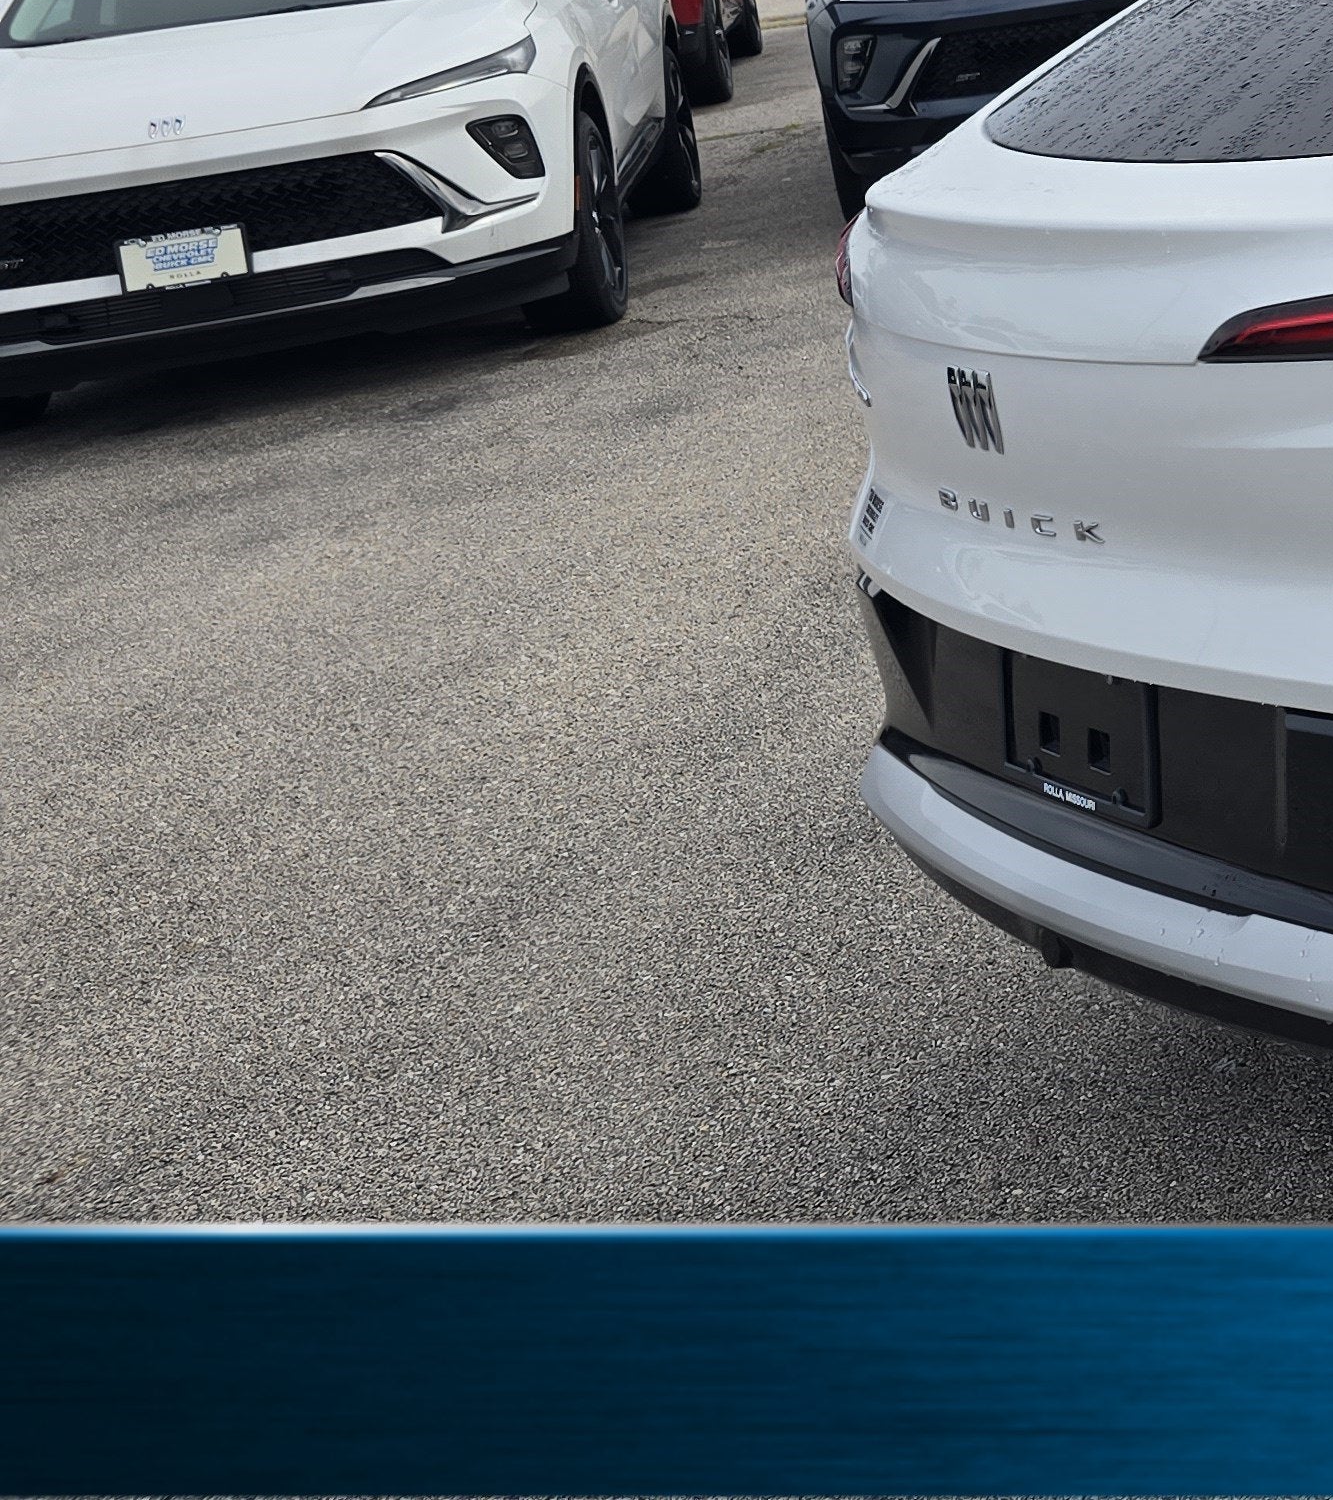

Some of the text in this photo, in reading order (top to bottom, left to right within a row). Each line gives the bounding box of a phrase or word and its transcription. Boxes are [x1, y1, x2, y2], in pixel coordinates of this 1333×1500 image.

[146, 238, 218, 259] ED MORSE
[152, 248, 214, 264] CHEVROLET
[938, 487, 1105, 544] BUICK
